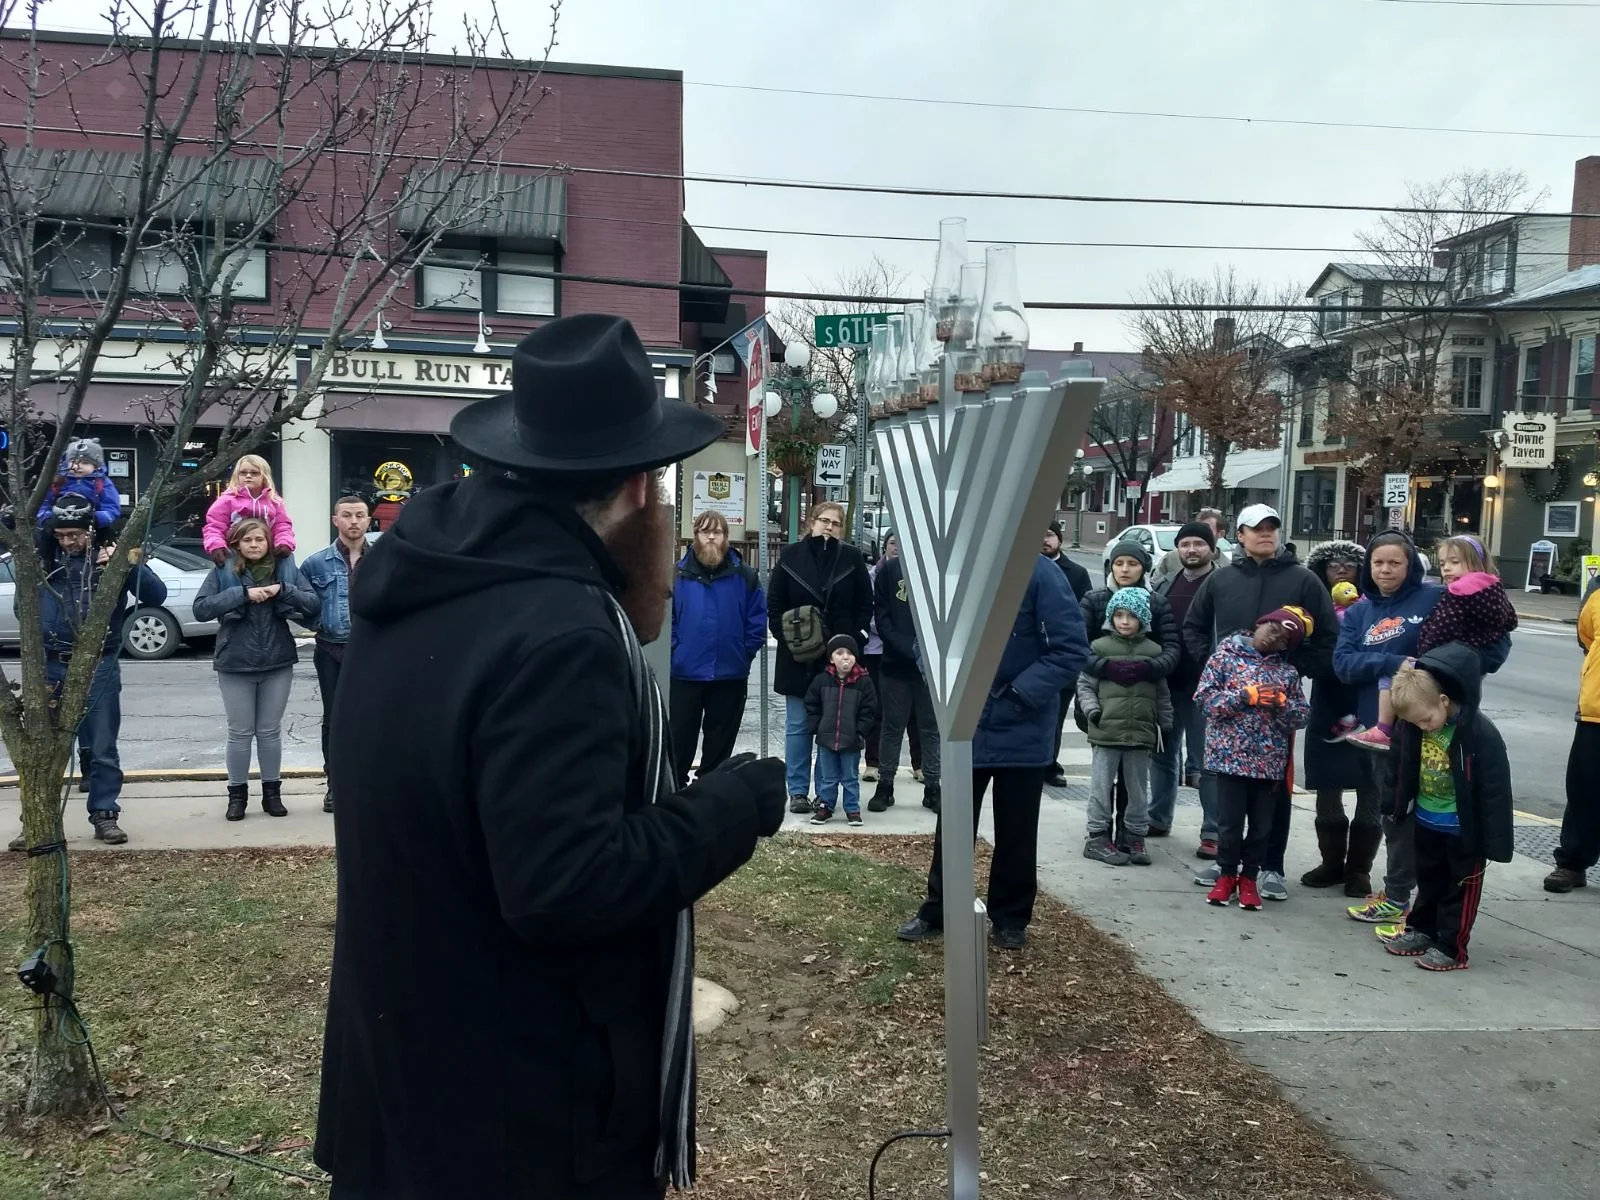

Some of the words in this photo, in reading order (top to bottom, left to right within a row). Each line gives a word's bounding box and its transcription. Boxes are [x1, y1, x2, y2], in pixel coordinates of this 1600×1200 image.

[825, 327, 833, 344] S
[838, 317, 875, 343] 6TH
[331, 356, 402, 380] BULL
[415, 359, 471, 383] RUN
[1513, 433, 1544, 445] Towne
[822, 448, 841, 458] ONE
[1512, 447, 1545, 458] Tavern
[821, 459, 841, 469] WAY
[1387, 491, 1407, 504] 25
